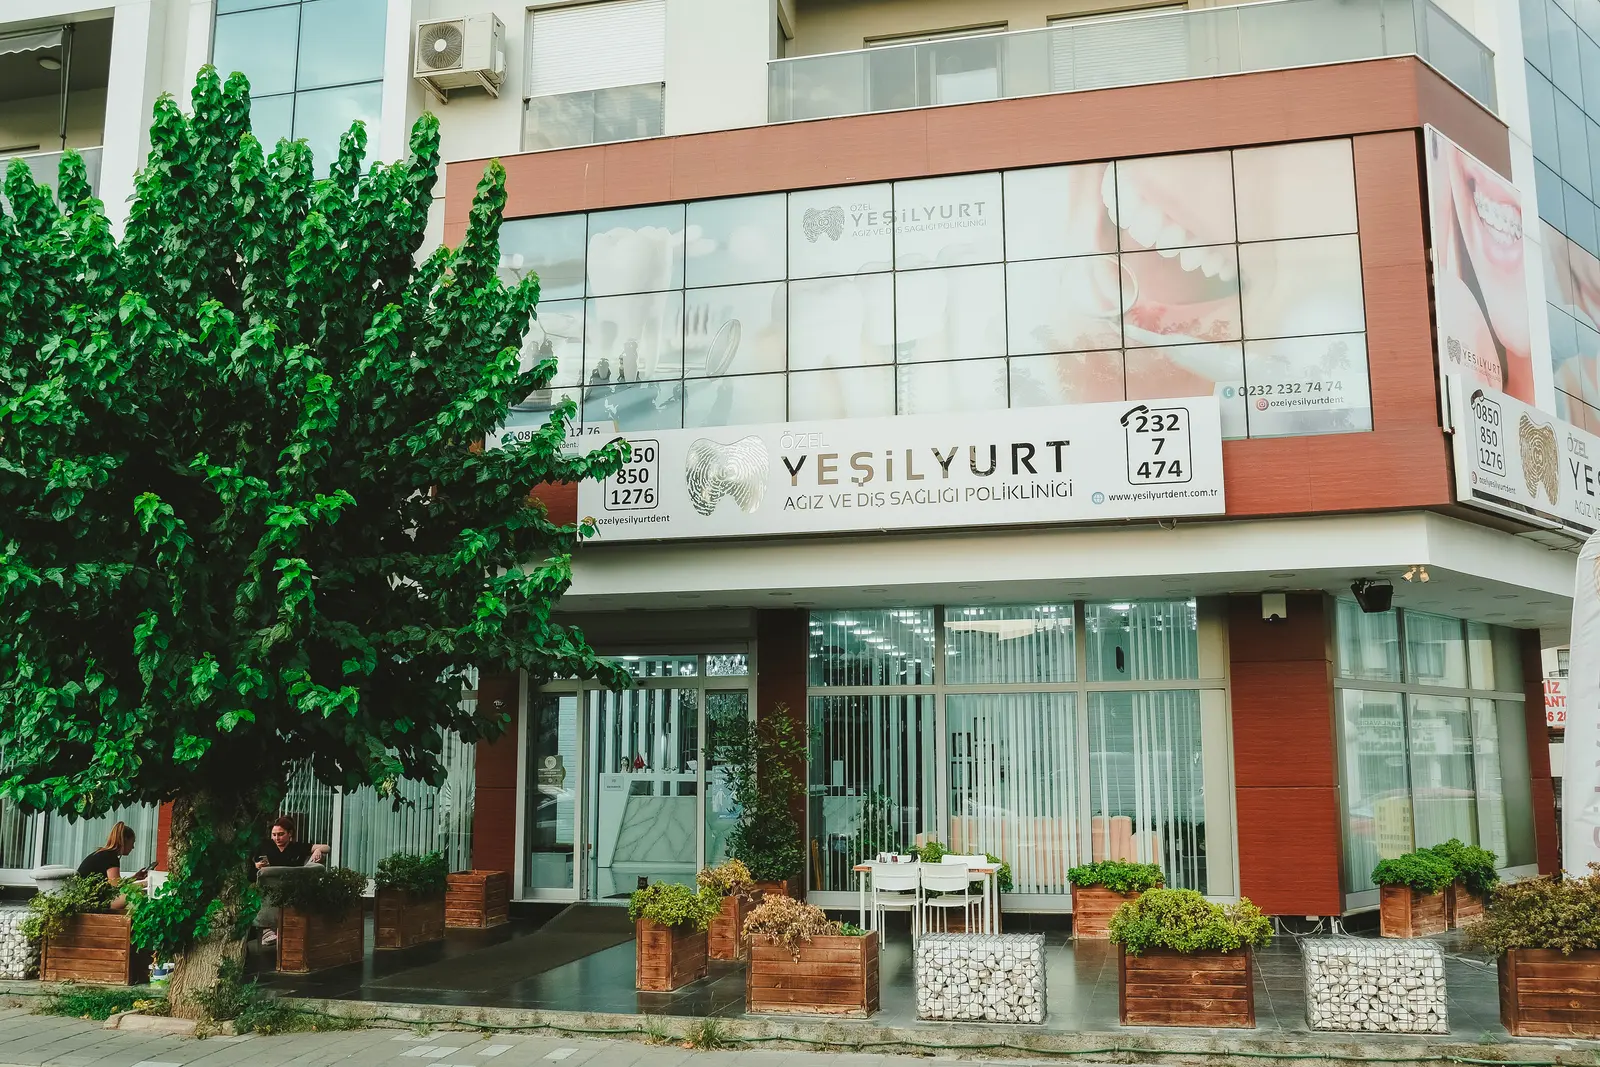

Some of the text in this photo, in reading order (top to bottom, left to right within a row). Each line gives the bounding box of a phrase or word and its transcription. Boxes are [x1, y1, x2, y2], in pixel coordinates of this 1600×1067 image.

[1238, 380, 1343, 397] 0232 232 74 74
[1135, 413, 1180, 433] 232
[1476, 402, 1500, 427] 0850
[780, 430, 830, 450] ÖZEL
[1151, 437, 1165, 455] 7
[1481, 426, 1498, 448] 850
[1480, 447, 1503, 471] 1276
[616, 468, 649, 484] 850
[1136, 460, 1183, 479] 474
[1569, 457, 1600, 497] YE
[611, 488, 654, 505] 1276
[829, 493, 852, 509] VE
[1108, 488, 1218, 501] www.yesilyurtdent.com.tr
[598, 515, 670, 526] ozelyesilyurtdent
